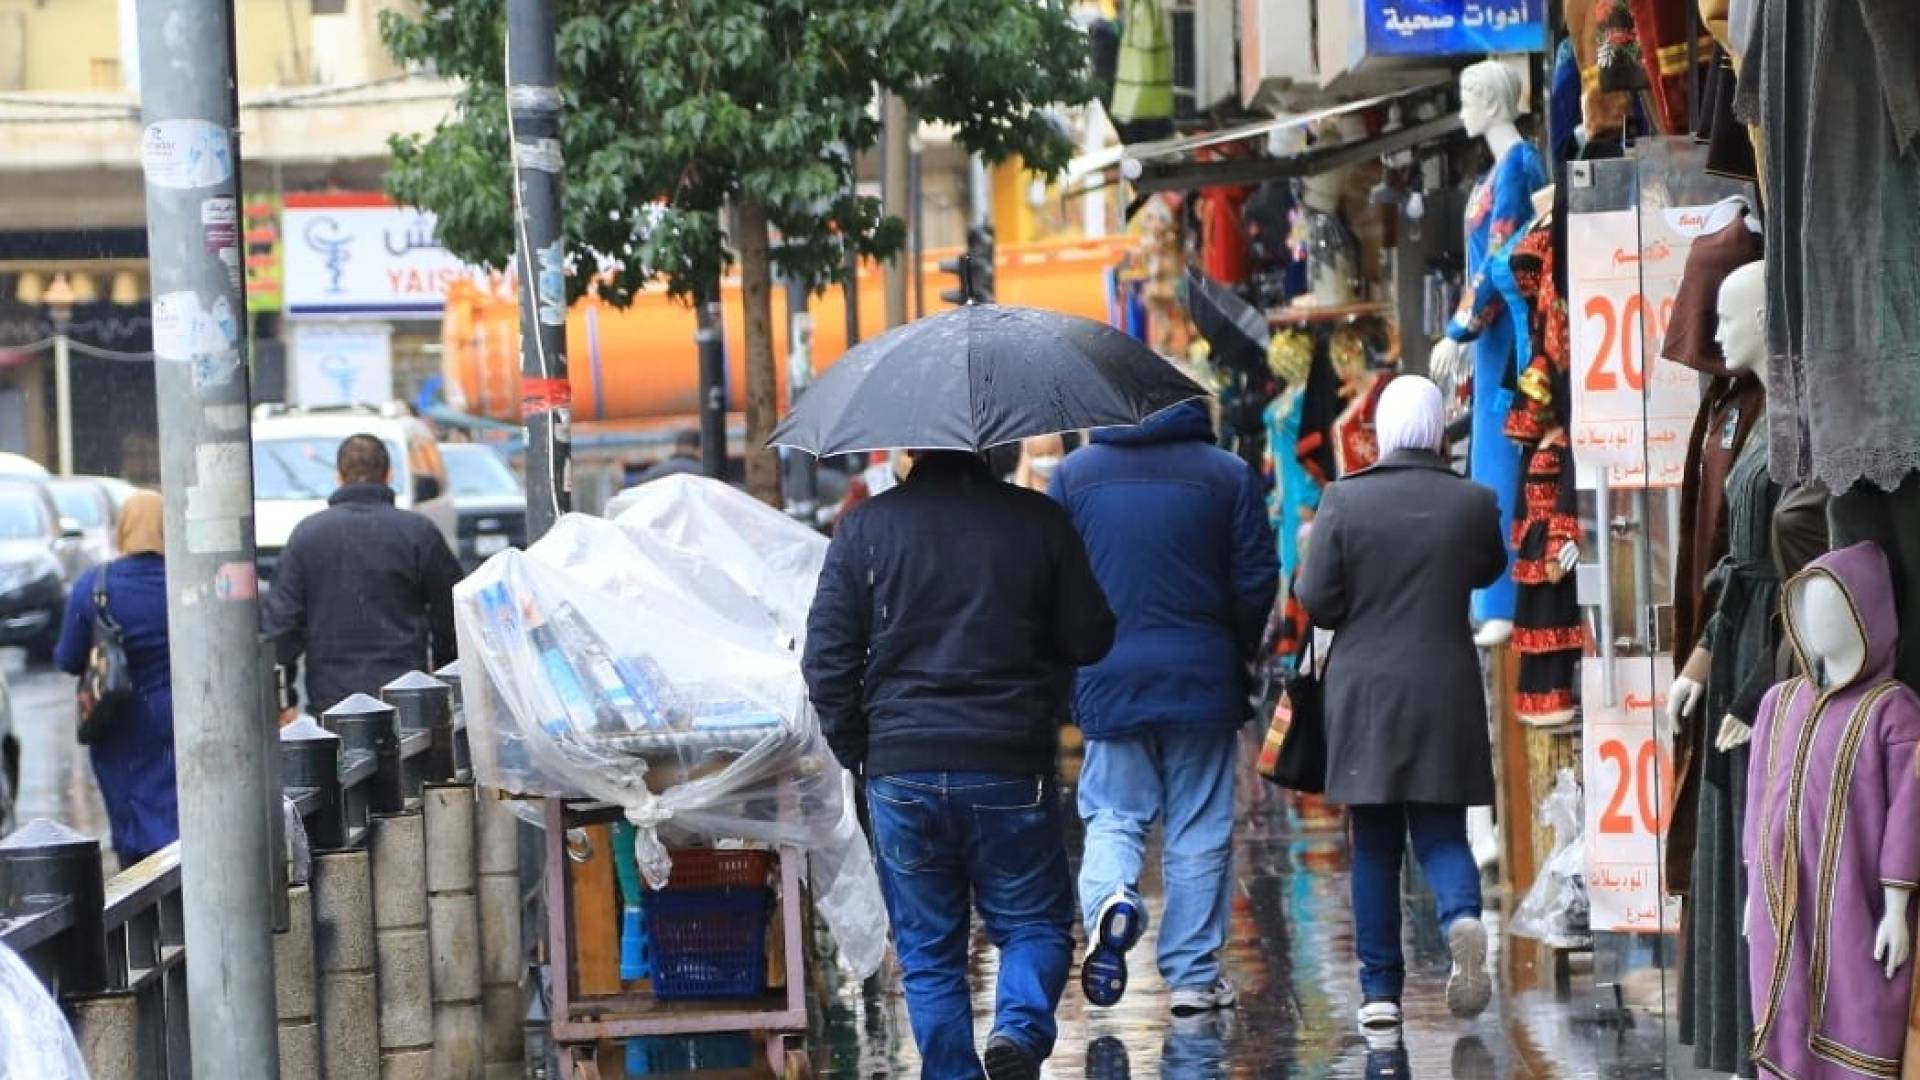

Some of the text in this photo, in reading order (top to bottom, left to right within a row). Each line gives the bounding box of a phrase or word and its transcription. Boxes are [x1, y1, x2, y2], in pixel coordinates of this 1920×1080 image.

[1383, 0, 1528, 37] أدوات صحية
[1599, 739, 1674, 836] 20
